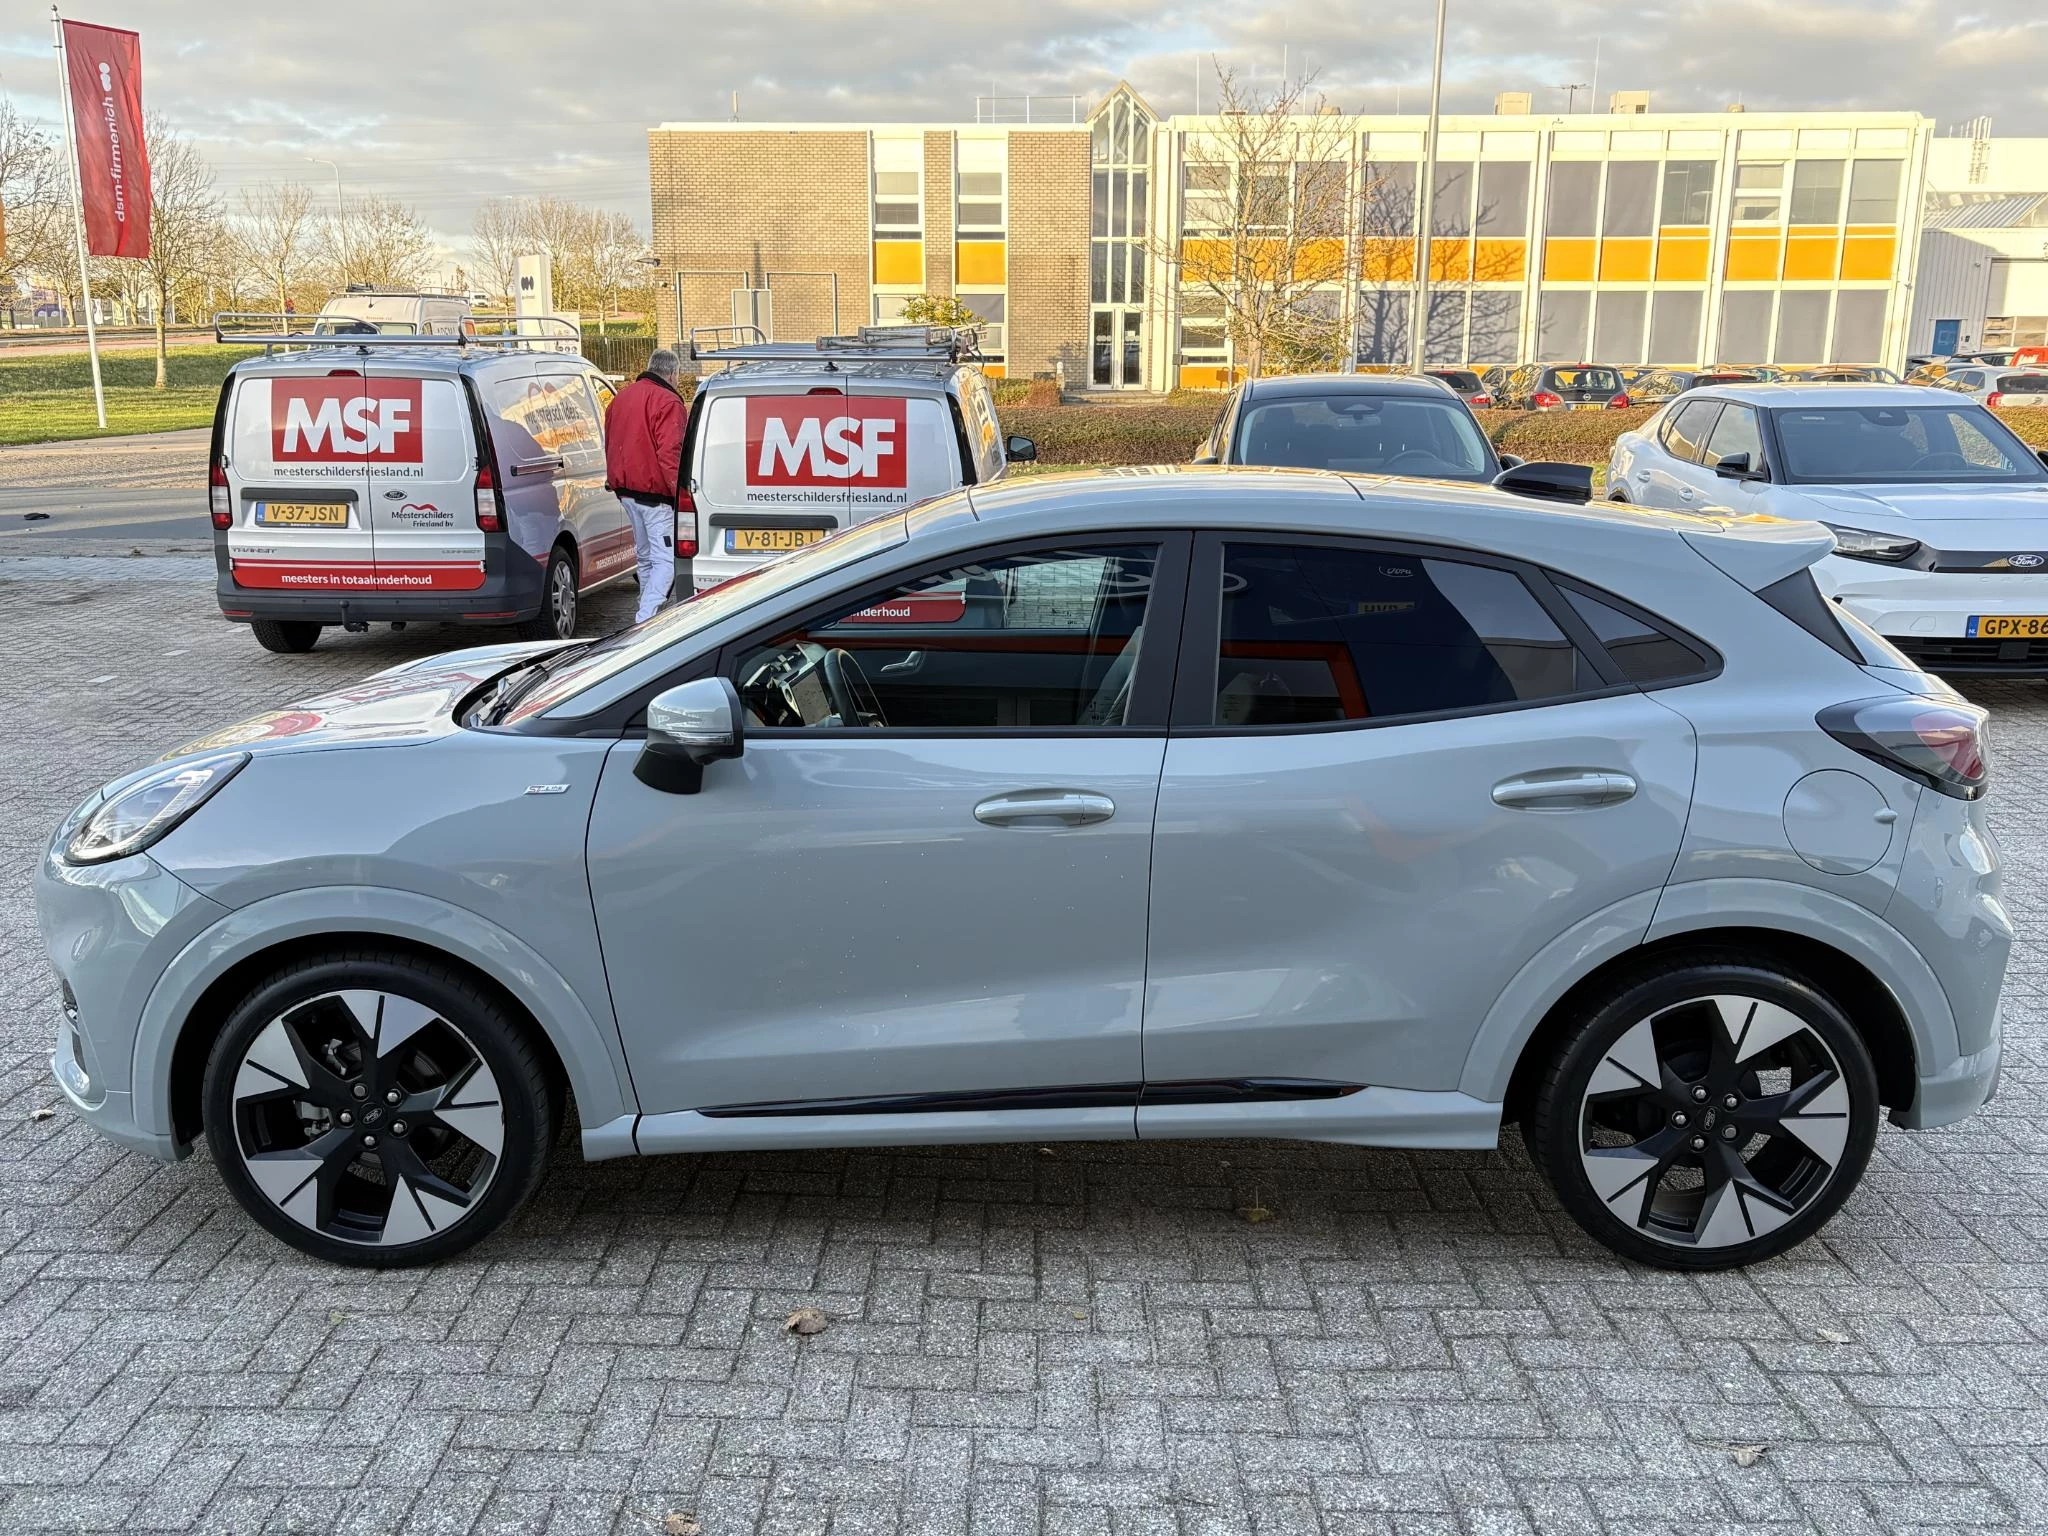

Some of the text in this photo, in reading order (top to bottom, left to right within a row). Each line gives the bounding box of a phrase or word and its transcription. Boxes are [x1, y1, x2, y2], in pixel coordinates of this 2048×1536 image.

[102, 96, 126, 223] dsm-firmenich
[282, 396, 411, 455] MSF
[757, 416, 896, 478] MSF
[273, 466, 424, 478] meesterschildersfriesland.nl
[747, 491, 907, 503] meesterschildersfriesland.nl
[271, 505, 339, 521] V-37-JSN
[391, 511, 454, 519] Meesterschilders
[281, 573, 433, 585] meesters in totaalonderhoud
[850, 605, 911, 617] nderhoud
[1984, 619, 2048, 635] GPX-86
